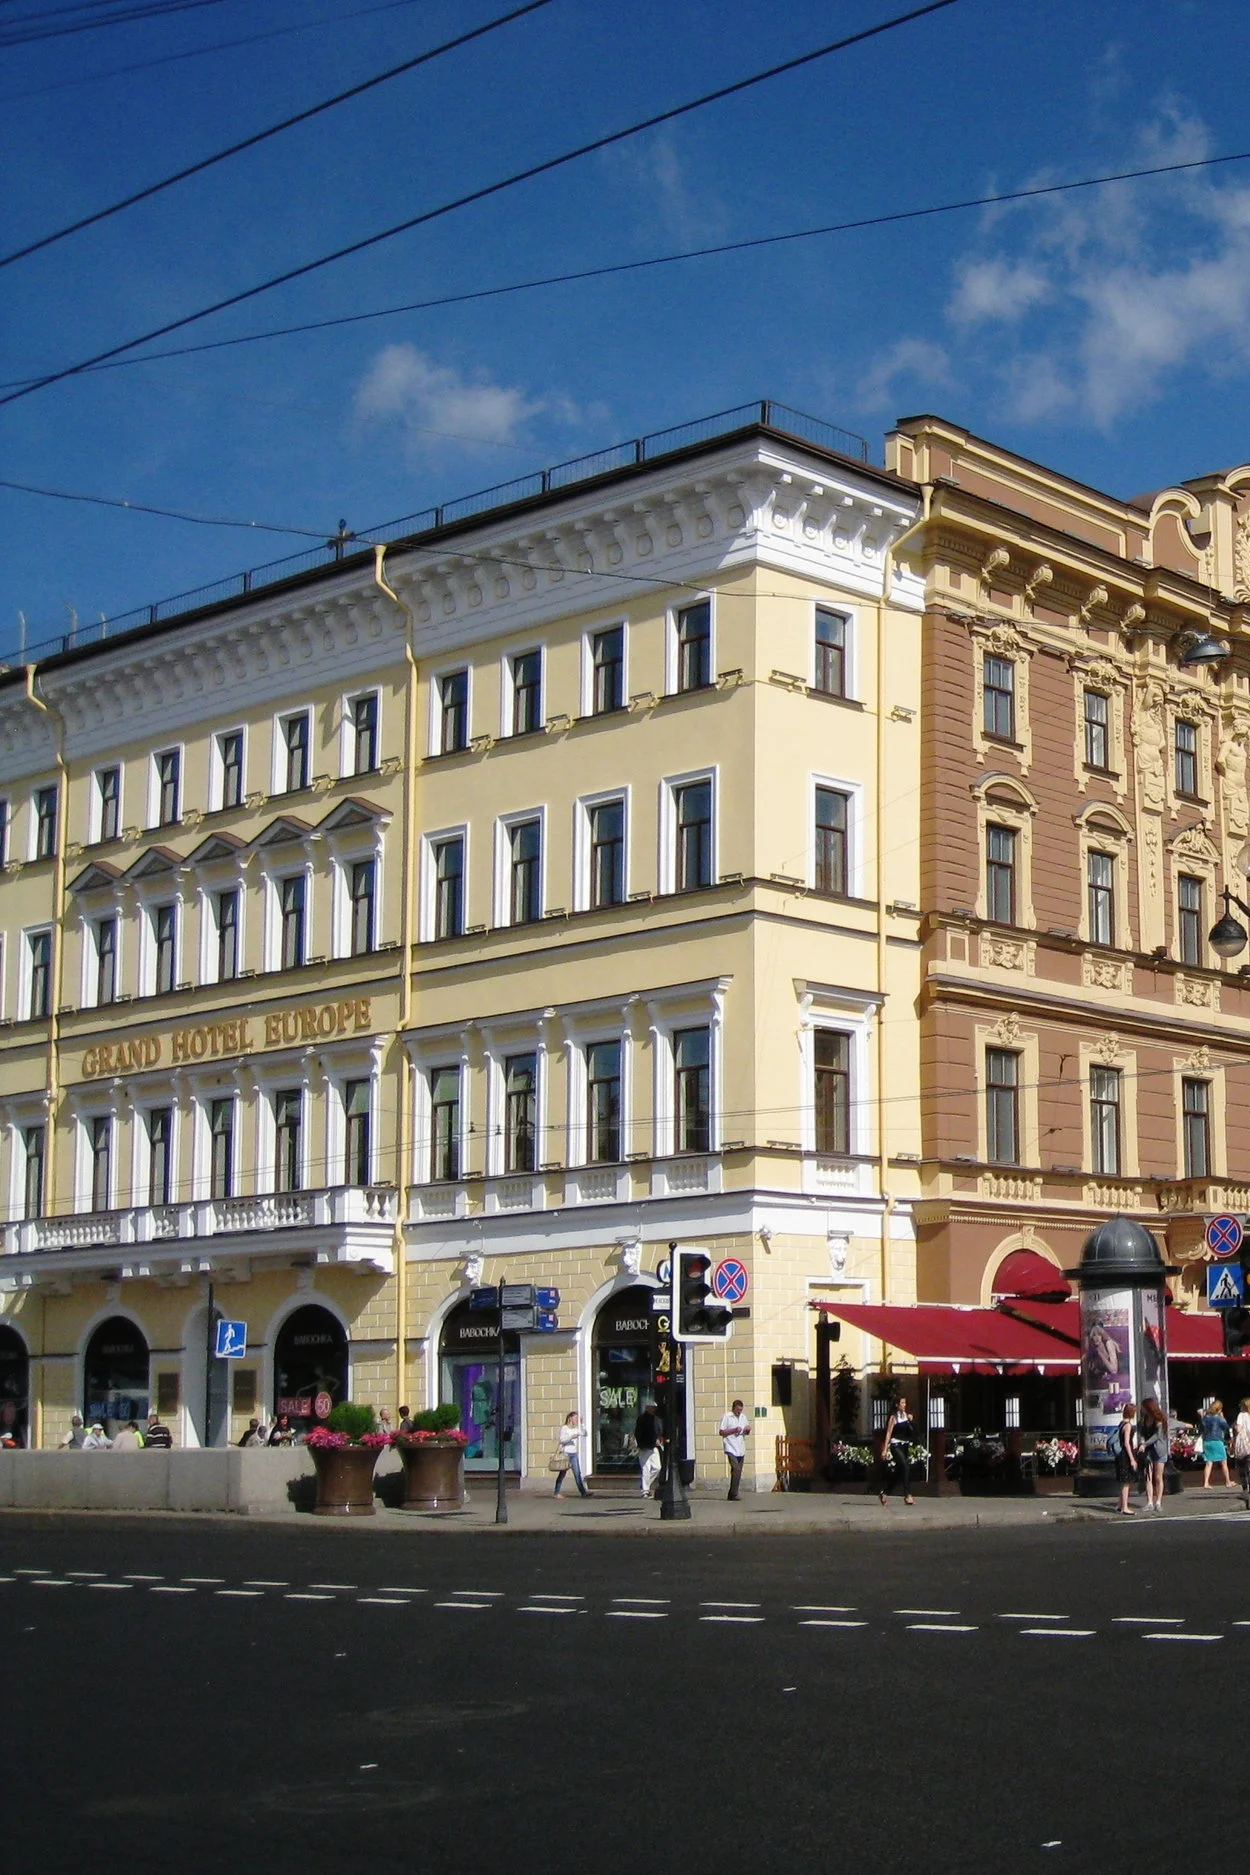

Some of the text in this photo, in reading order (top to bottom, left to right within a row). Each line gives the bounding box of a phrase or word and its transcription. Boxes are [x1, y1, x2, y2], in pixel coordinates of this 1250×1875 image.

[83, 997, 371, 1078] GRAND HOTEL EUROPE
[280, 1398, 308, 1414] SALE
[600, 1386, 637, 1408] SALE
